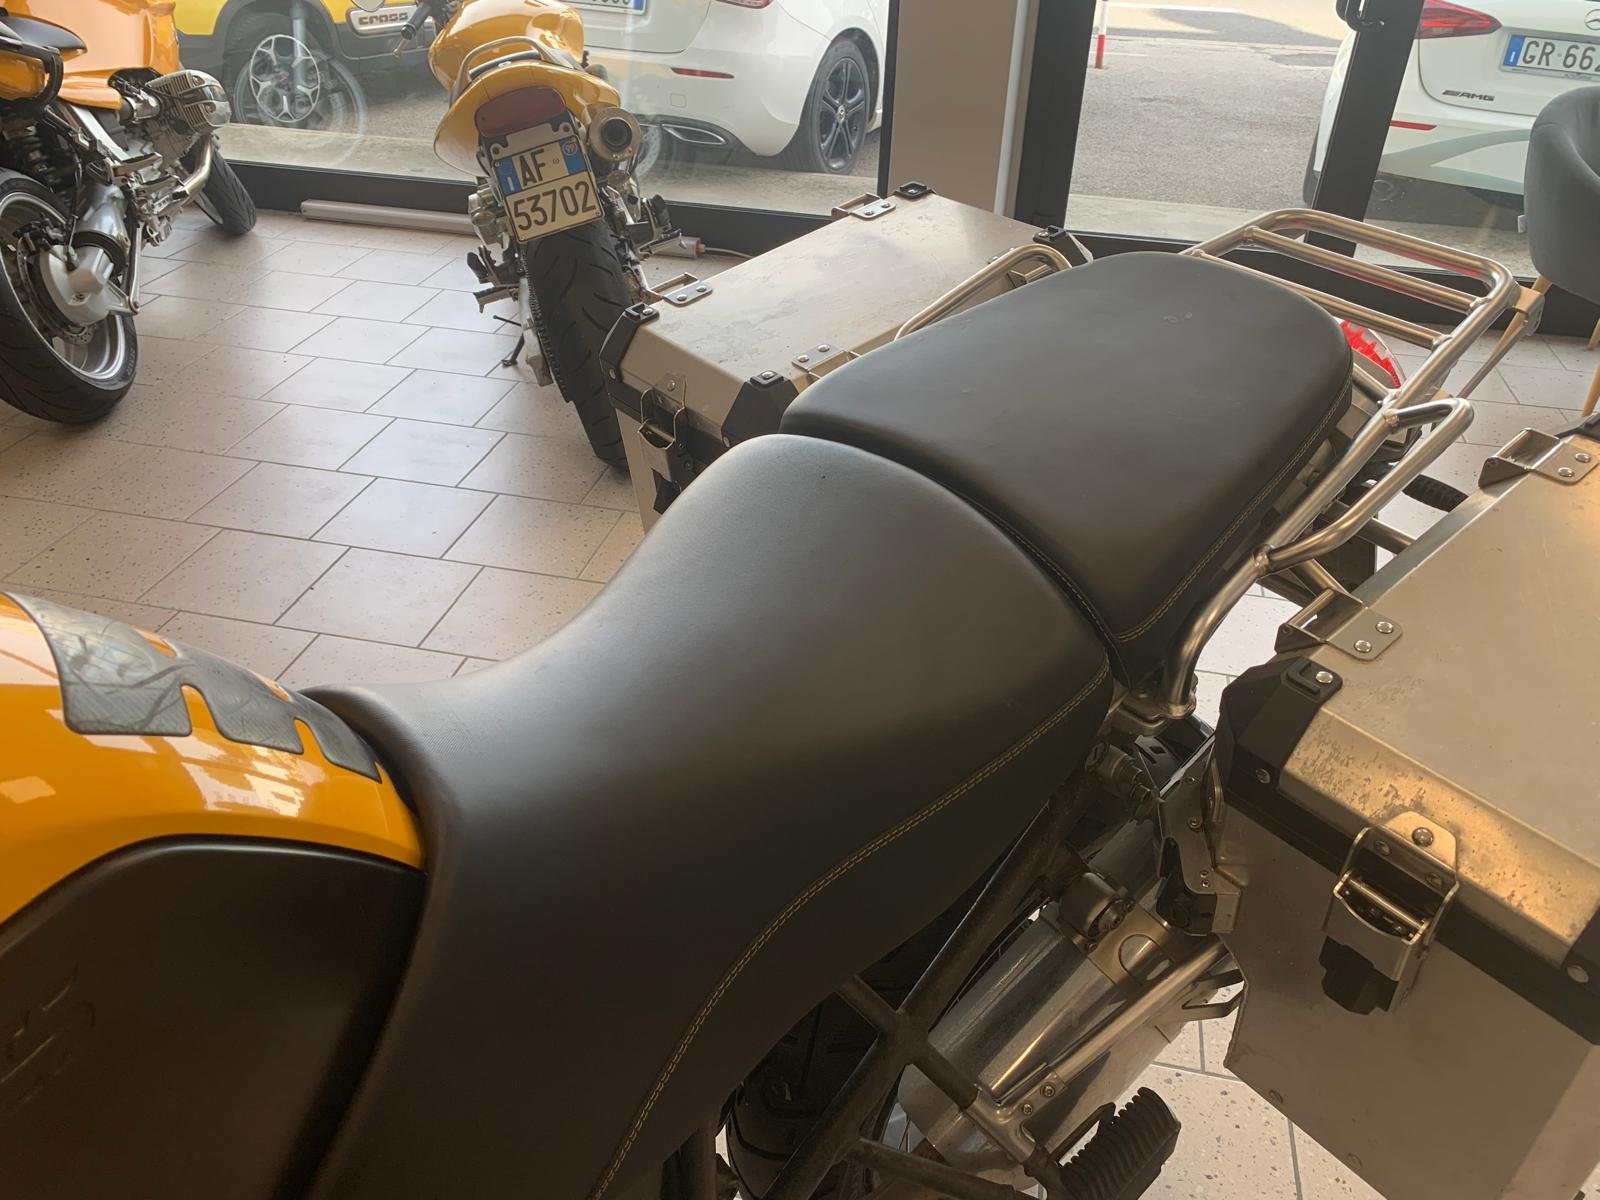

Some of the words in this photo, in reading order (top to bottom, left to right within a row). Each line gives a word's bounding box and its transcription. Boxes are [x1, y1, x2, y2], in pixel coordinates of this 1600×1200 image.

[358, 12, 408, 25] CROSS
[1522, 40, 1556, 67] GR
[1562, 44, 1600, 72] 66
[1459, 92, 1495, 102] AMG
[519, 148, 546, 187] AF
[513, 181, 596, 231] 53702
